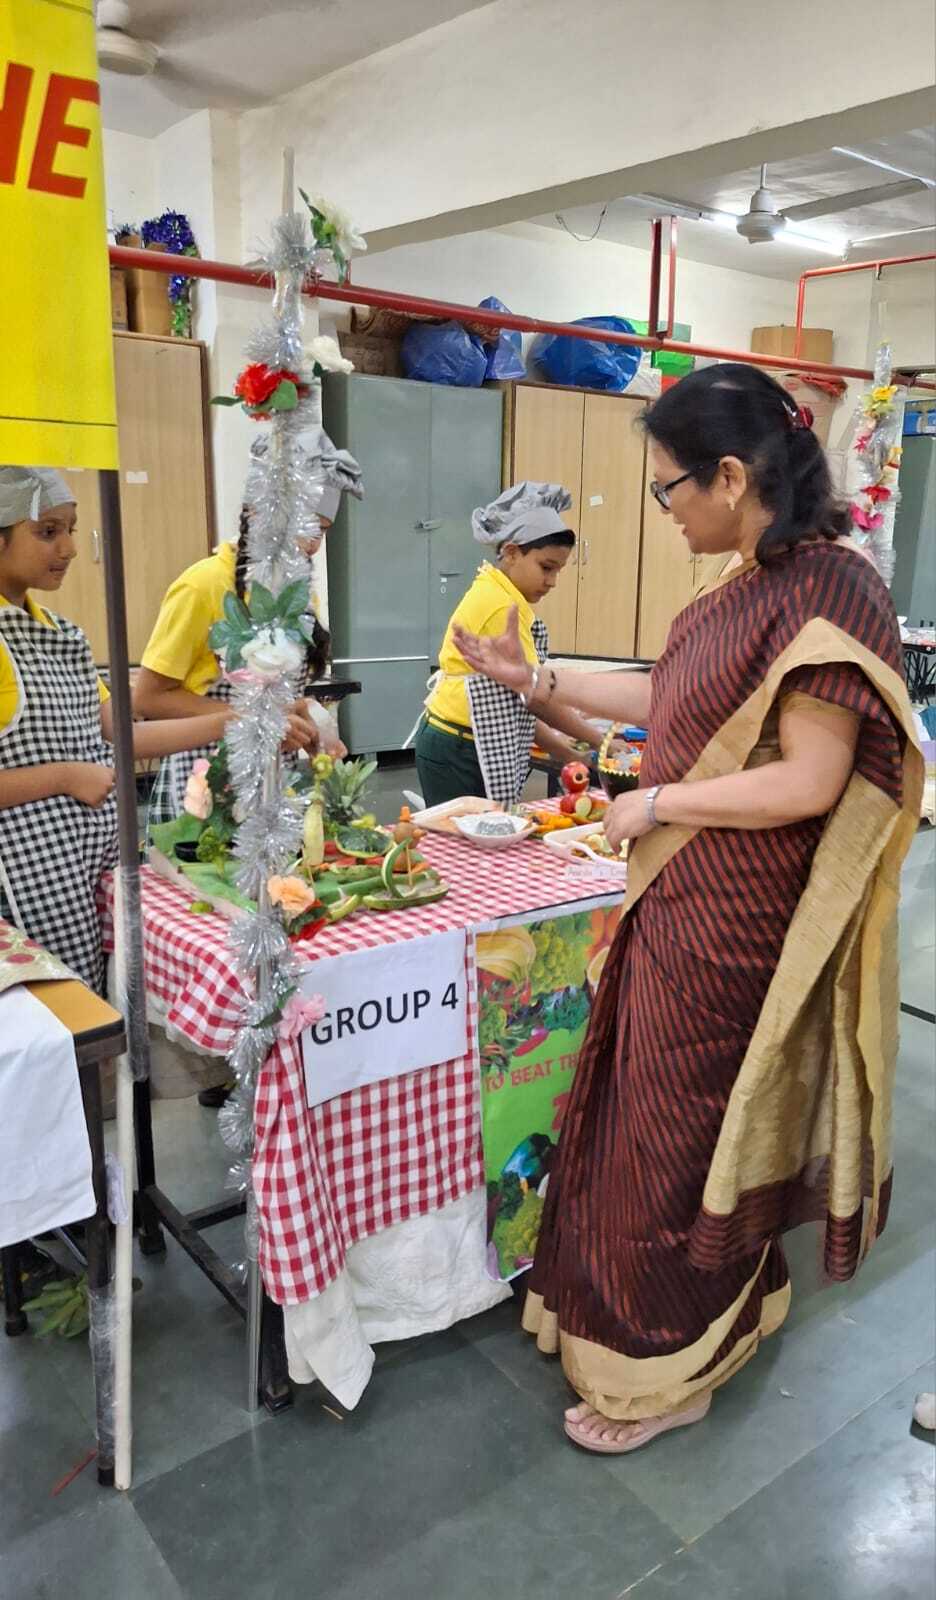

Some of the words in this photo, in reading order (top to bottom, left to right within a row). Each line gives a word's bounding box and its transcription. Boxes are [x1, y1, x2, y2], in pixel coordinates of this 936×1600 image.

[311, 988, 431, 1045] GROUP
[441, 982, 459, 1010] 4
[485, 1072, 505, 1093] TO
[511, 1058, 553, 1087] BEAT
[559, 1053, 578, 1071] TH
